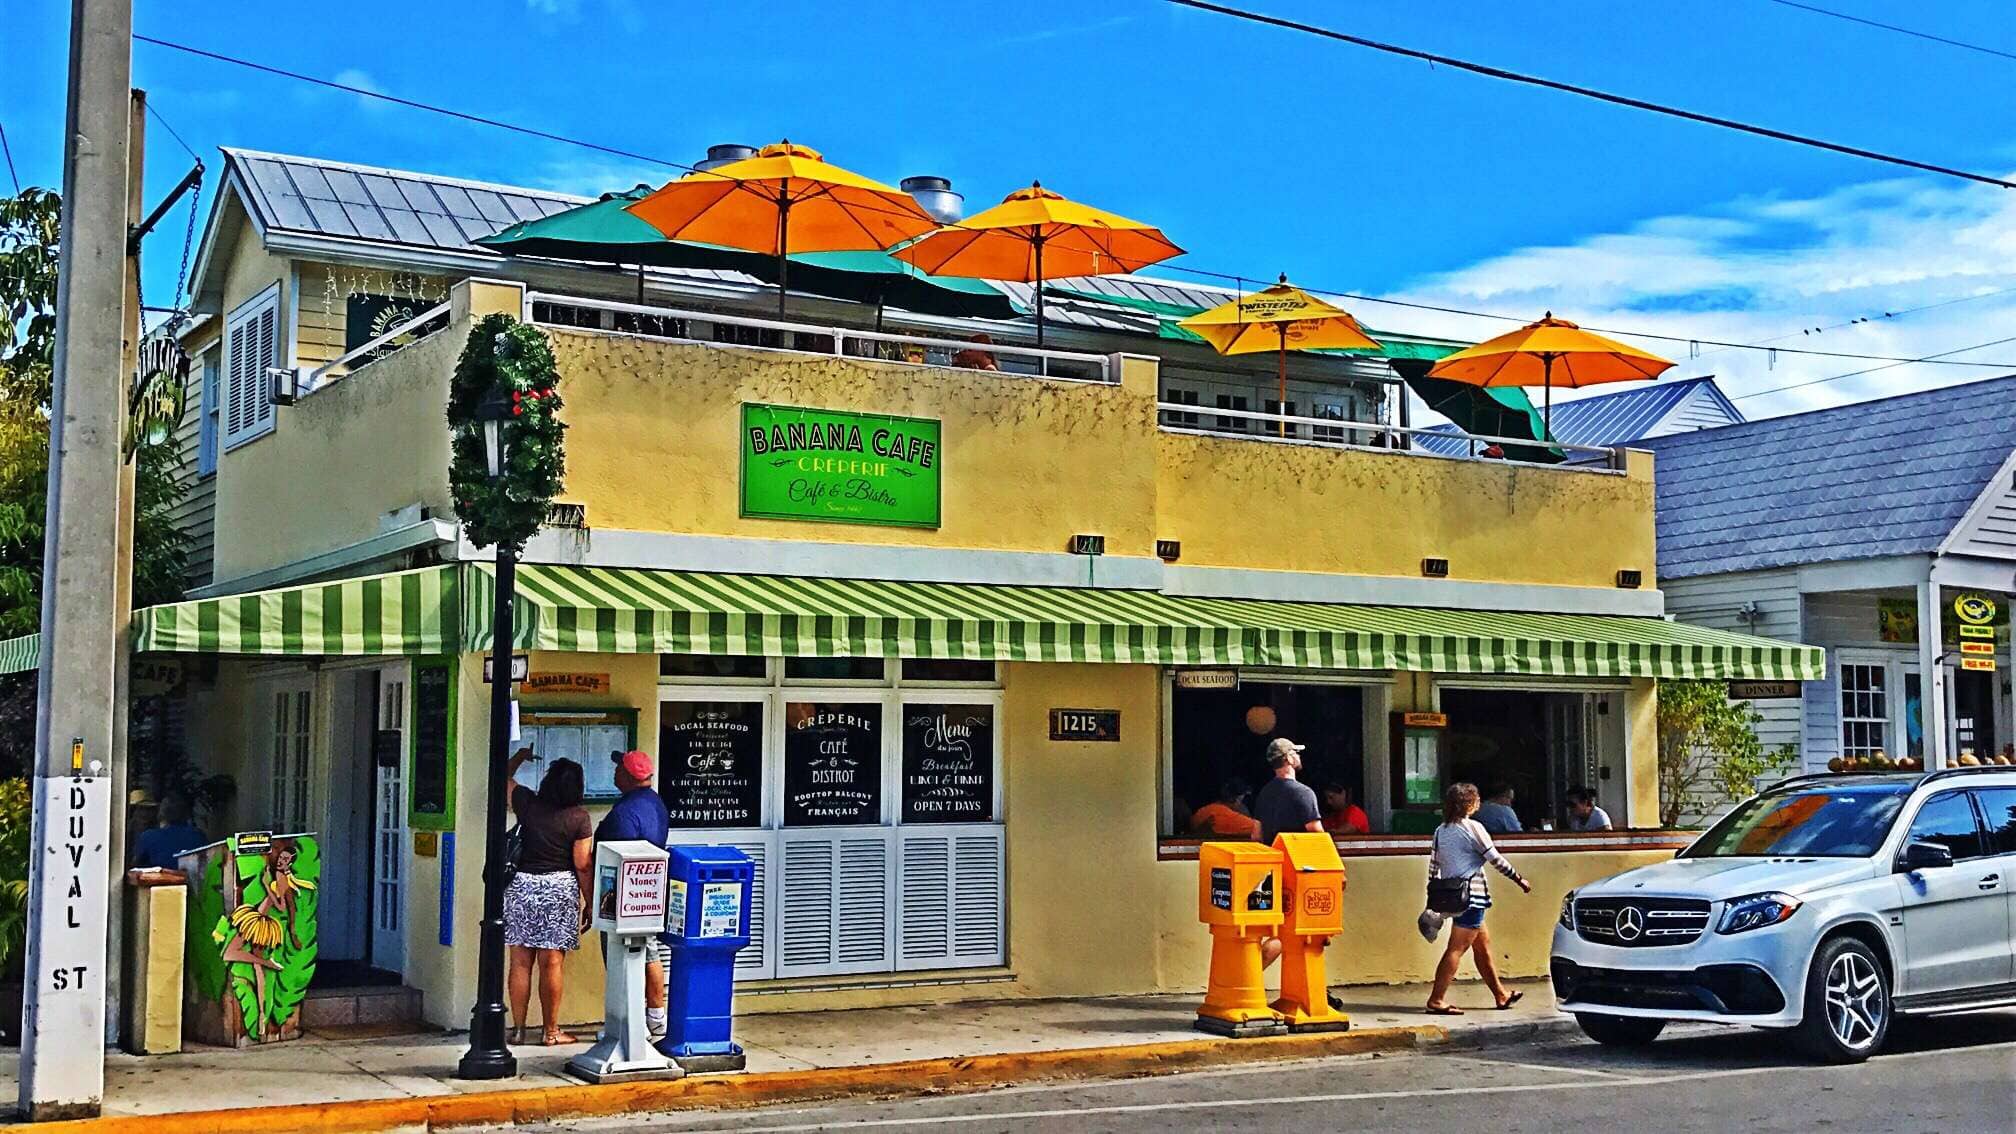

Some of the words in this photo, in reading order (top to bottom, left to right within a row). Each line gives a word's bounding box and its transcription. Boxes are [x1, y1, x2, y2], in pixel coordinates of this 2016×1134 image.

[369, 304, 399, 338] BANANA
[750, 422, 864, 456] BANANA
[872, 428, 935, 469] CAFE
[788, 478, 825, 506] Café
[829, 483, 841, 496] &
[846, 478, 898, 507] Bistro
[531, 674, 573, 689] BANANA
[575, 675, 600, 690] CAFE
[1745, 685, 1785, 695] DINNER
[674, 722, 704, 731] LOCAL
[706, 722, 749, 732] SEAFOOD
[1063, 715, 1097, 731] 1215
[925, 714, 972, 761] Menu
[819, 738, 848, 754] CAFÉ
[829, 757, 838, 767] &
[922, 758, 974, 774] Breakfast
[812, 770, 855, 783] BISTROT
[942, 774, 952, 785] &
[794, 790, 833, 802] ROOFTOP
[835, 790, 873, 800] BALCONY
[807, 807, 859, 817] FRANÇAIS
[913, 801, 943, 811] OPEN
[945, 801, 952, 811] 7
[955, 801, 981, 811] DAYS
[670, 809, 748, 821] SANDWICHES
[66, 787, 86, 929] DUVAL
[626, 863, 664, 876] FREE
[630, 877, 657, 888] Money
[629, 889, 658, 900] Saving
[705, 886, 722, 894] FREE
[623, 903, 661, 913] Coupons
[52, 966, 88, 991] ST
